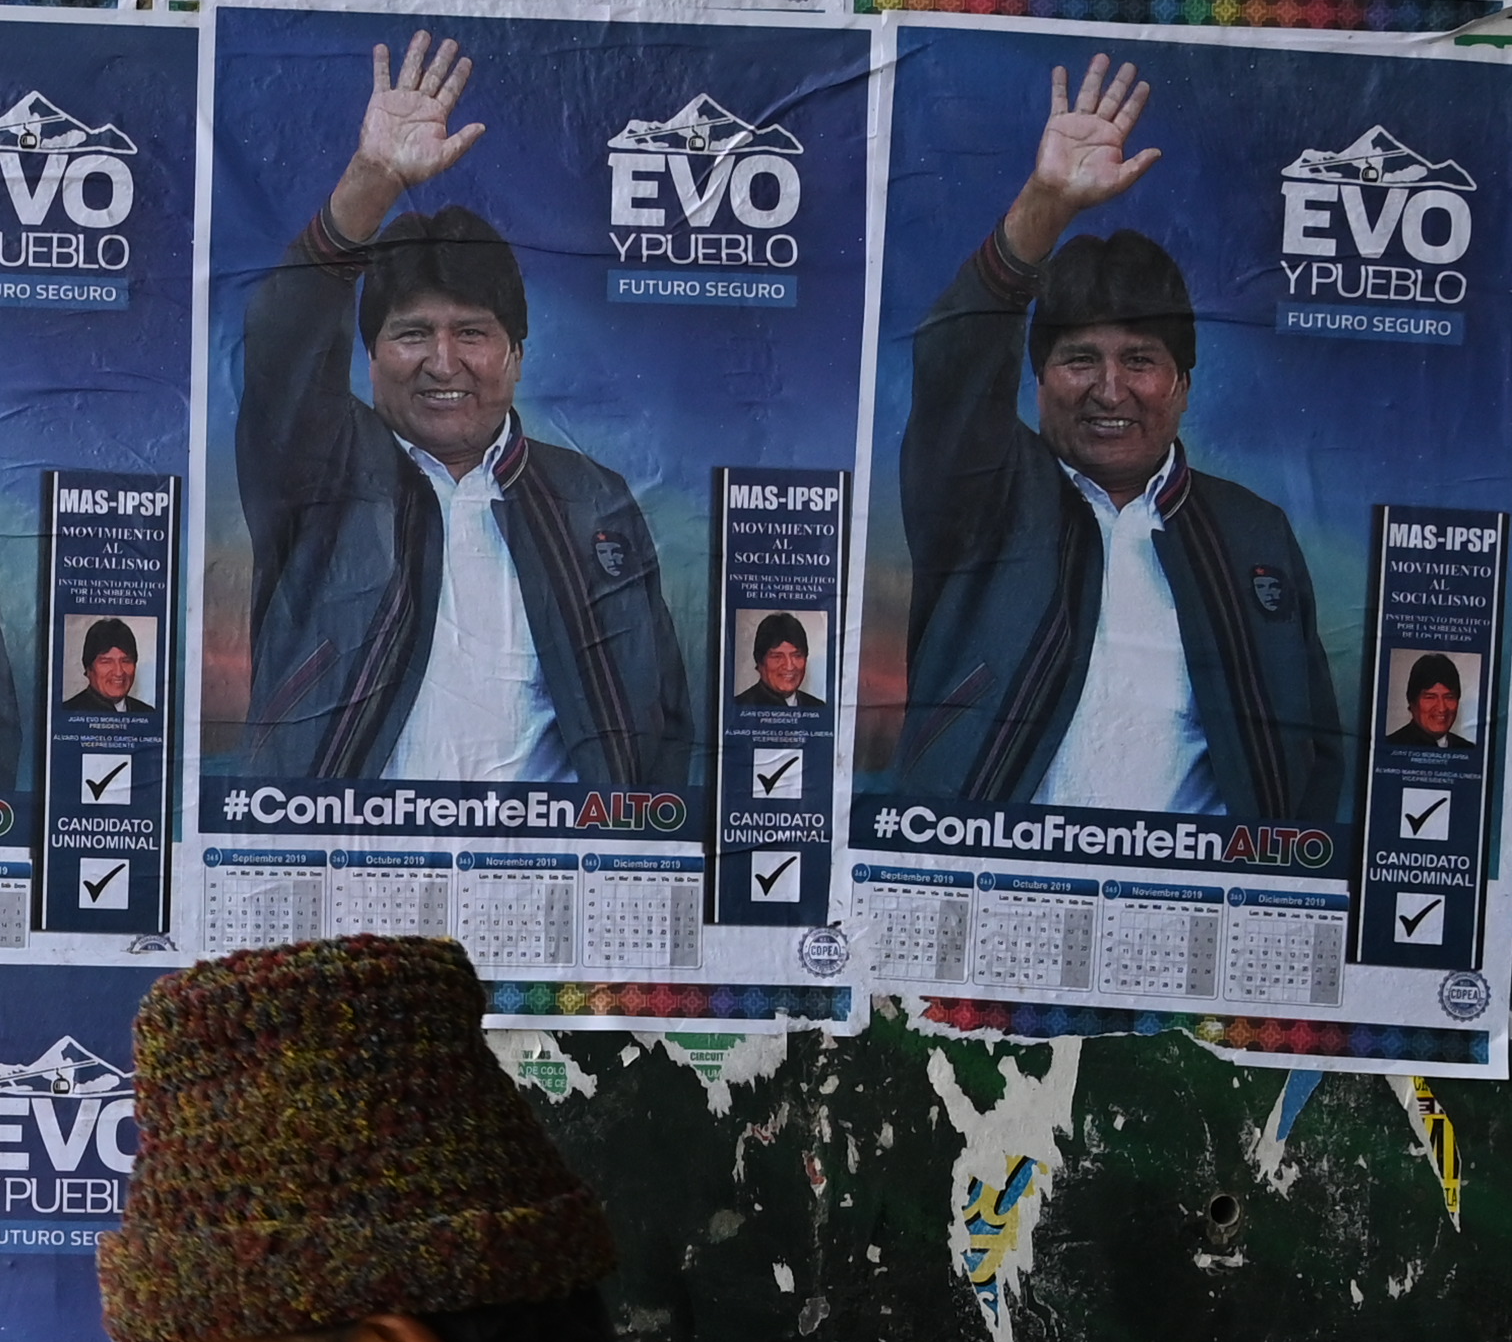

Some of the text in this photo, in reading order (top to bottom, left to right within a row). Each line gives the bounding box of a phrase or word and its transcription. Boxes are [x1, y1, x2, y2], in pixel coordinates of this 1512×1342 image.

[608, 153, 799, 229] EVO
[1281, 181, 1472, 263] EVO
[1287, 311, 1452, 335] FUTURO SEGURO
[62, 526, 165, 541] MOVIMIENTO
[102, 542, 123, 554] AL
[63, 556, 160, 571] SOCIALISMO
[222, 785, 687, 832] #ConLaFrenteEnALTO
[58, 817, 153, 833] CANDIDATO
[52, 834, 158, 850] UNINOMINAL
[875, 805, 1334, 868] #ConLaFrenteEnALTO
